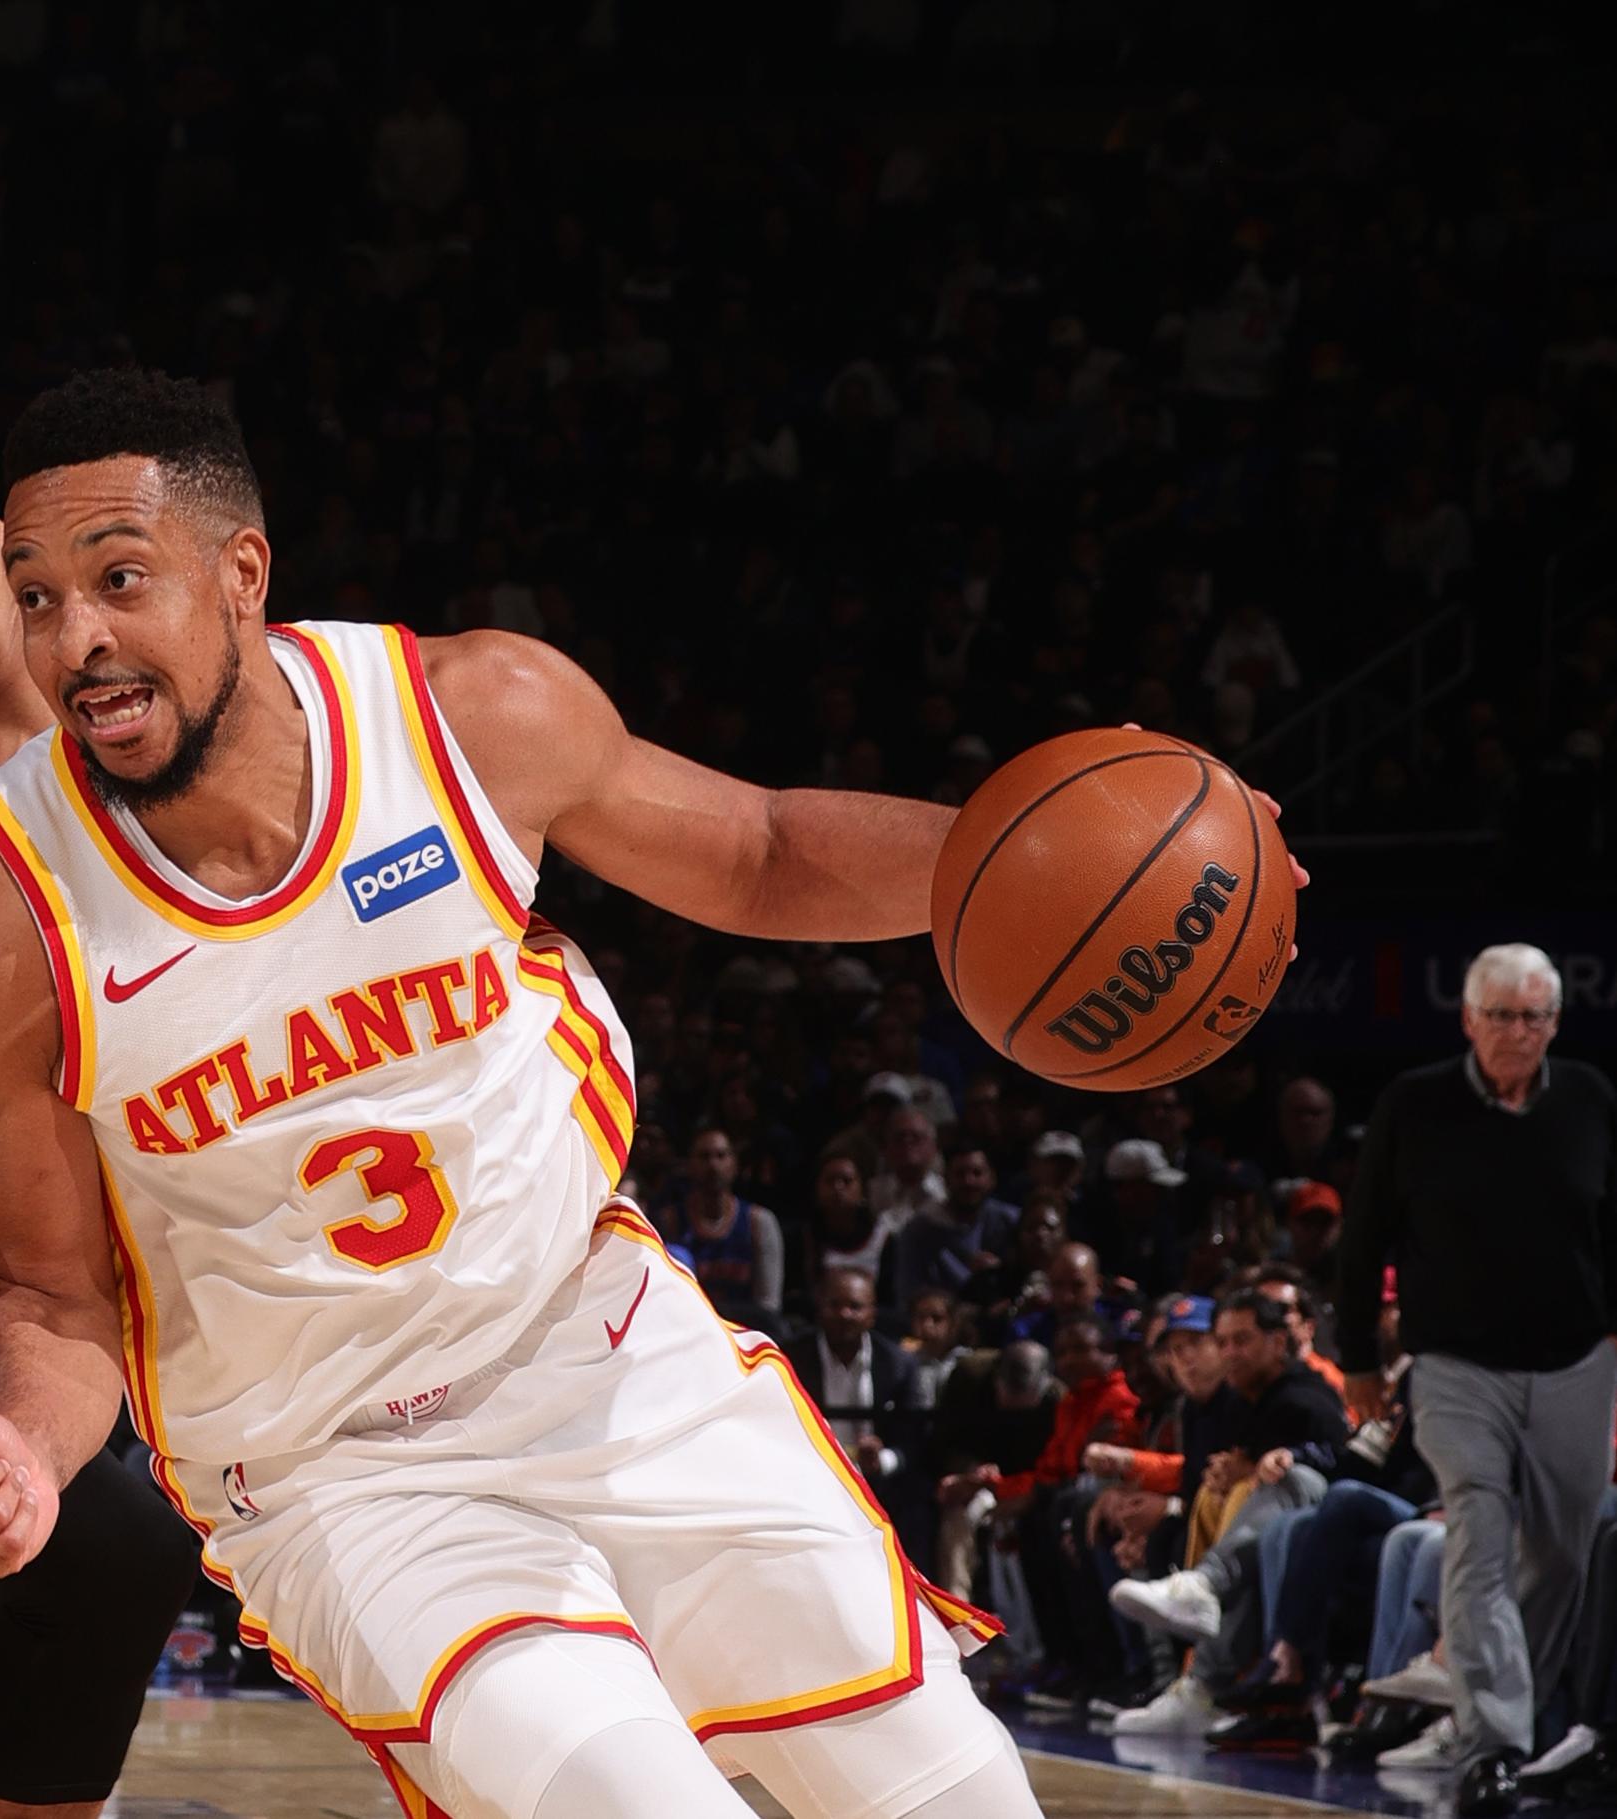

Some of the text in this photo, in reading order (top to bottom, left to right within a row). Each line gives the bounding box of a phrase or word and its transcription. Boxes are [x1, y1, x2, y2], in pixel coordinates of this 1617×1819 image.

[352, 844, 445, 910] paze
[1043, 861, 1241, 1056] Wilson
[121, 944, 510, 1155] ATLANTA
[296, 1127, 459, 1274] 3
